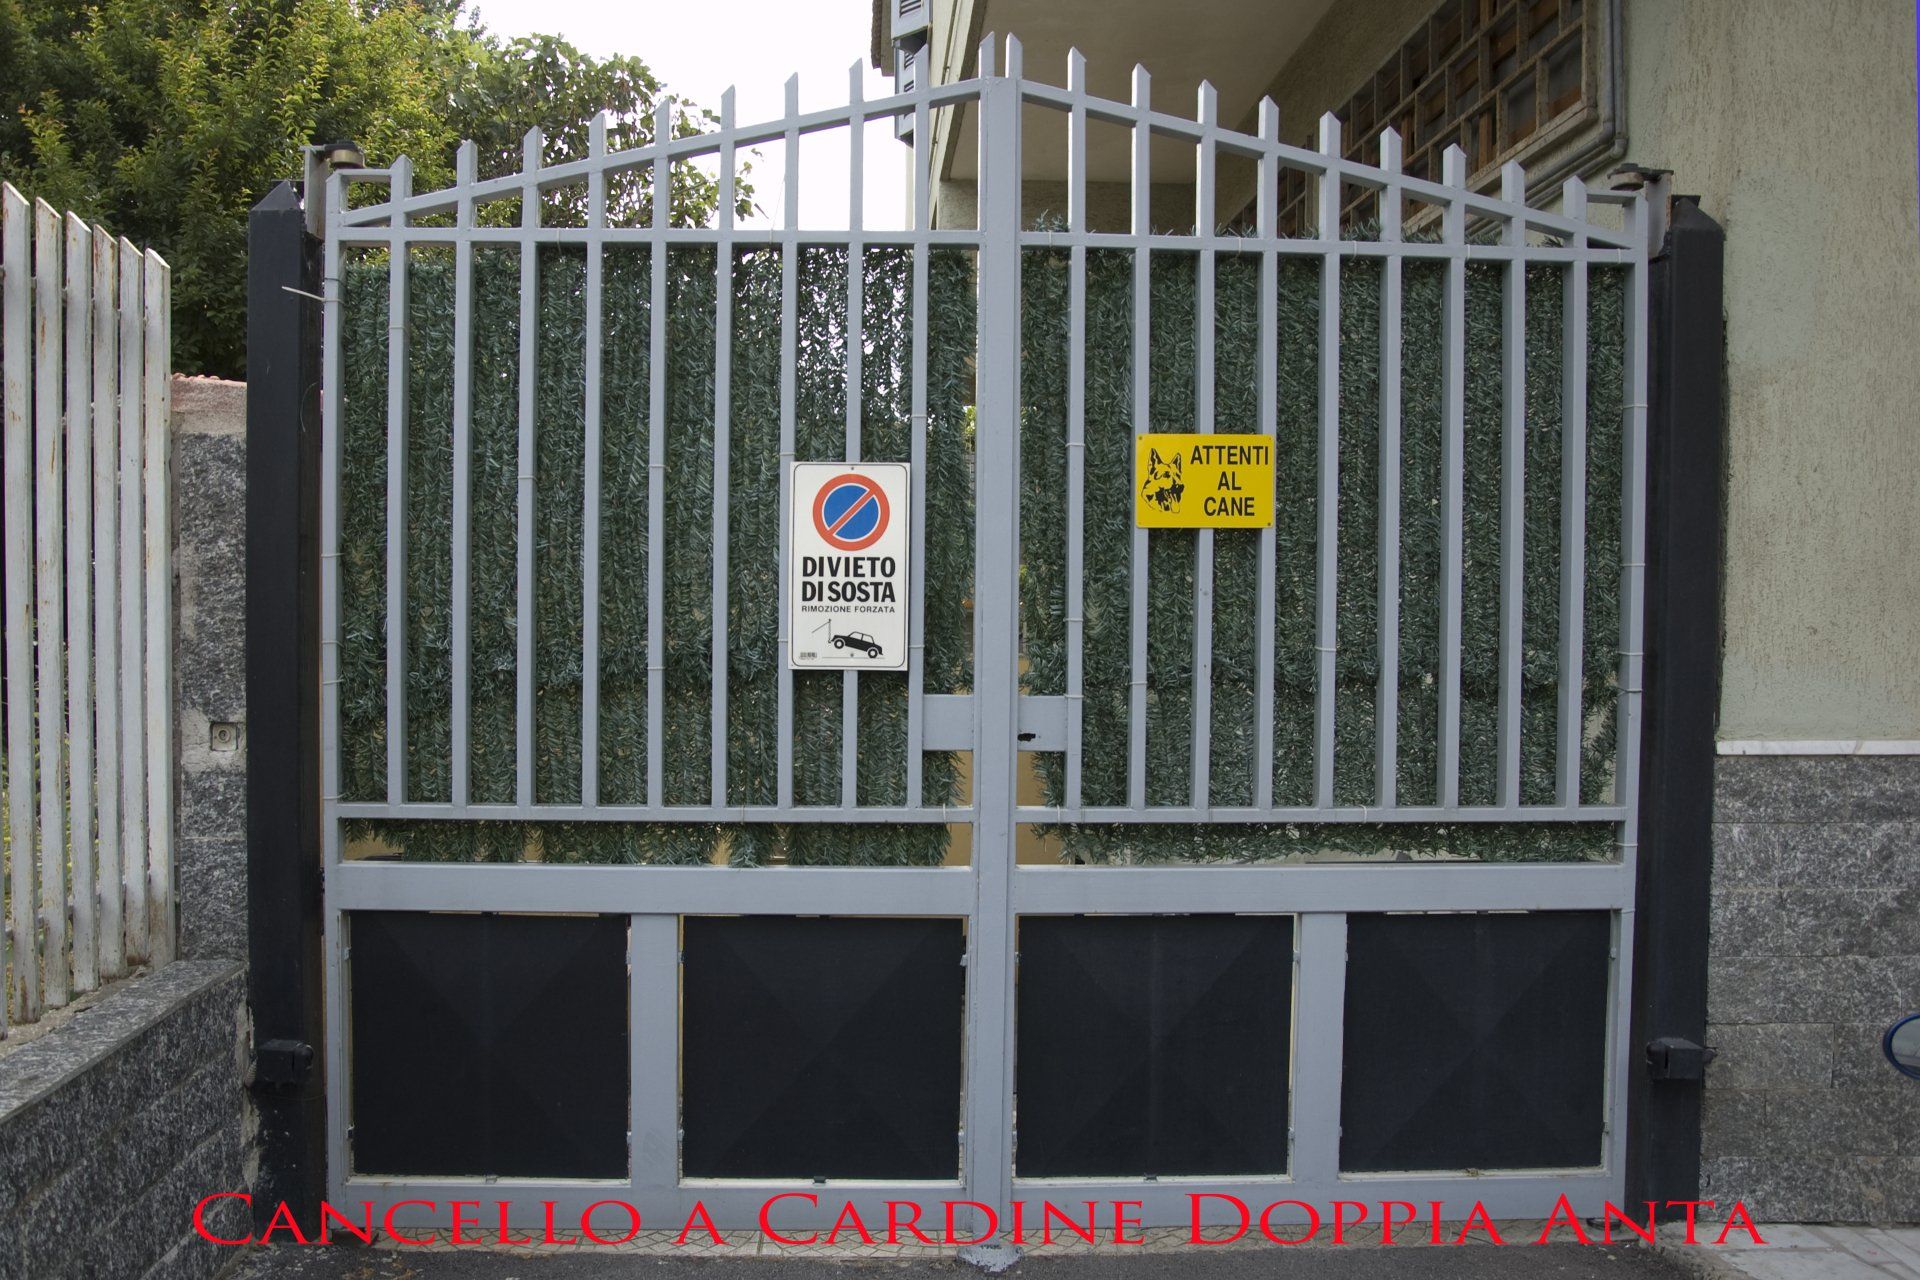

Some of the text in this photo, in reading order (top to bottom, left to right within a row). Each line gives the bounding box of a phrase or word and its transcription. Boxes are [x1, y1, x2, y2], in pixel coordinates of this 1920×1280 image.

[1190, 445, 1269, 465] ATTENTI
[1217, 471, 1242, 491] AL
[1203, 497, 1255, 516] CANE
[802, 556, 896, 578] DIVIETO
[801, 581, 896, 603] DI SOSTA
[801, 605, 896, 613] RIMOZIONE FORZATA
